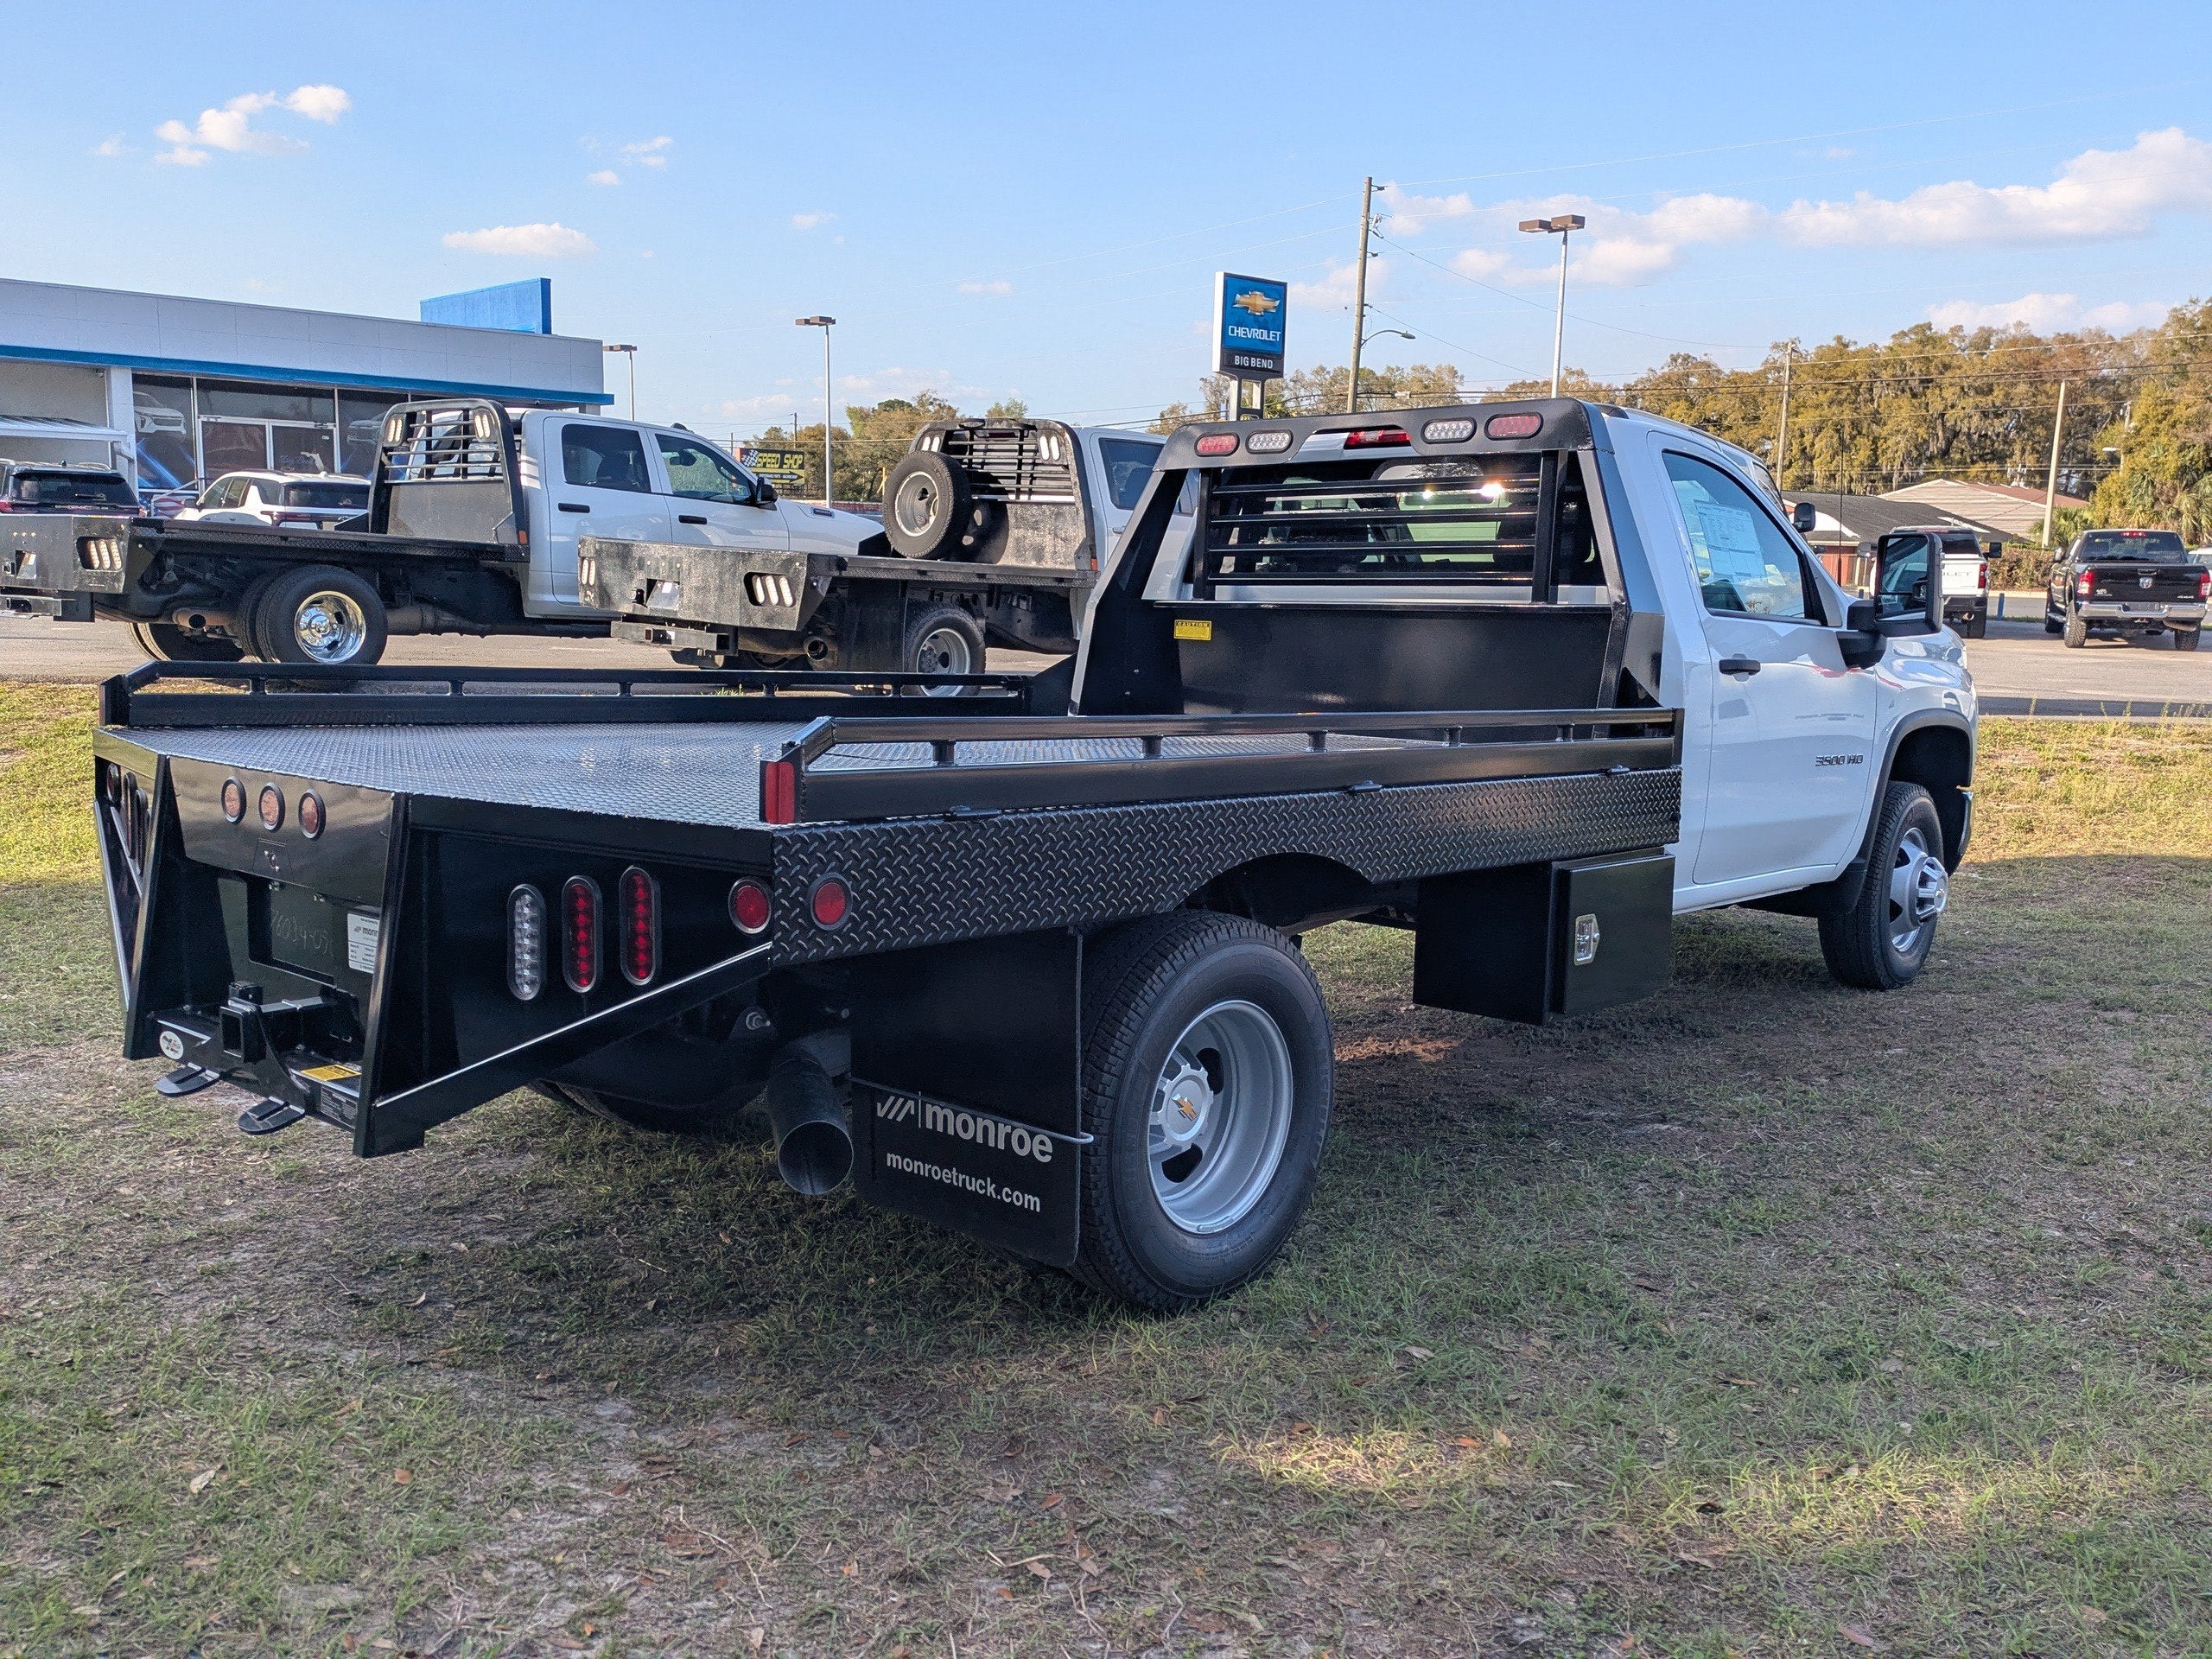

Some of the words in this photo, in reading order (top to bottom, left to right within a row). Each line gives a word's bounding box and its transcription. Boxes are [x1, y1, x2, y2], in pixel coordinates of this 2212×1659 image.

[1228, 325, 1281, 341] CHEVROLET
[1234, 355, 1249, 366] BIG
[1250, 357, 1274, 369] BEND
[757, 453, 781, 468] SPEED
[783, 454, 804, 469] SHOP
[1815, 755, 1846, 766] 3500
[1847, 754, 1864, 765] HD
[925, 1103, 1053, 1163] monroe
[887, 1153, 1040, 1212] monroetruck.com
